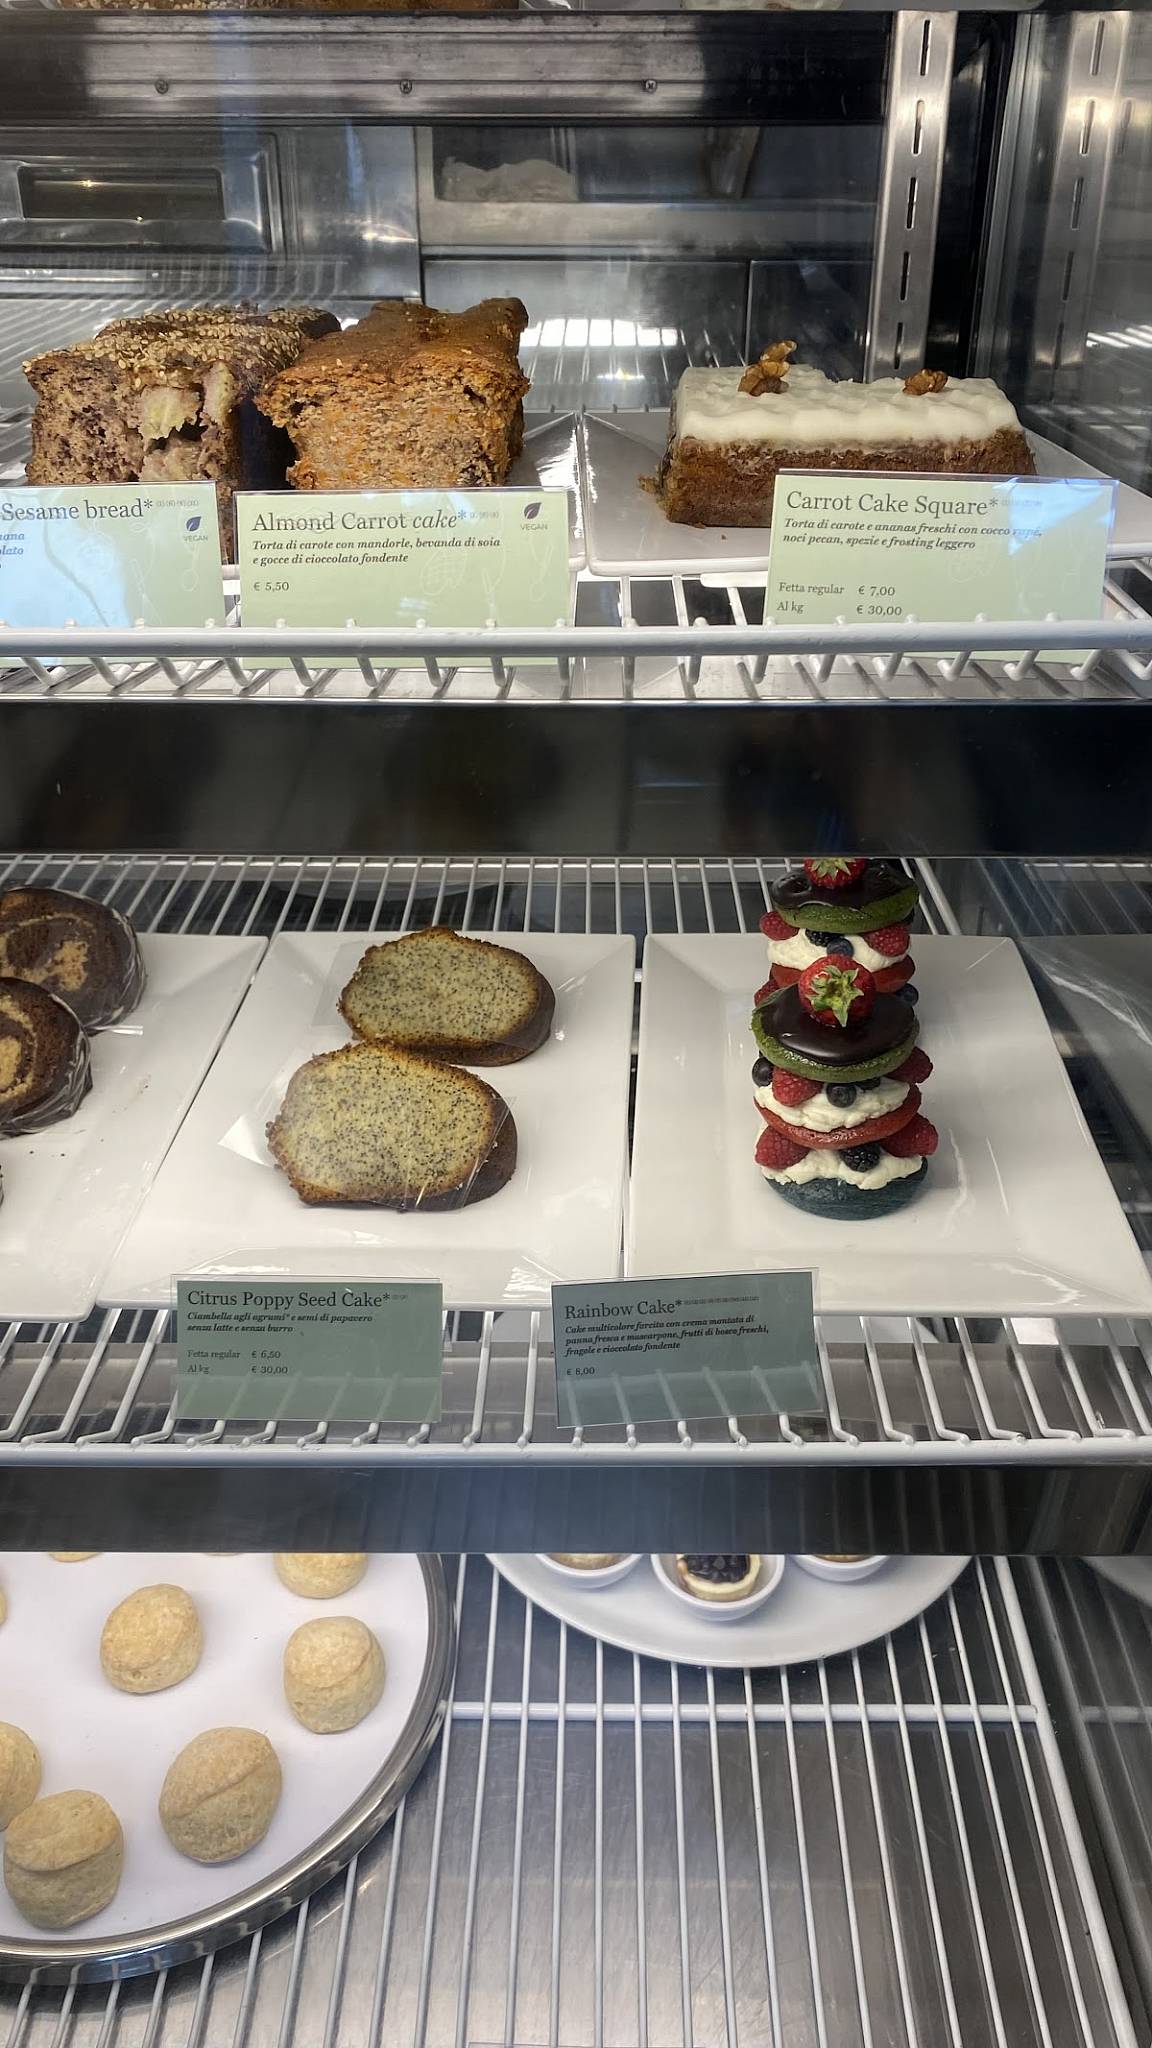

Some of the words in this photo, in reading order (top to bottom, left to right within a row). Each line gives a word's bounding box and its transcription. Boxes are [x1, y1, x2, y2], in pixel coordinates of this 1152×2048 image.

[786, 490, 852, 511] Carrot
[858, 493, 909, 513] Cake
[2, 503, 79, 521] Sesame
[252, 512, 334, 531] Almond
[341, 512, 407, 530] Carrot
[784, 518, 815, 529] Torta
[817, 519, 828, 529] di
[830, 520, 865, 530] carote
[874, 524, 916, 532] ananas
[915, 523, 957, 535] freschi
[958, 526, 977, 534] con
[981, 528, 1010, 536] cocco
[253, 541, 283, 550] Torta
[286, 540, 297, 549] di
[300, 540, 333, 549] carote
[357, 538, 413, 549] mandorle,
[416, 538, 461, 547] bevanda
[464, 538, 475, 547] di
[478, 538, 500, 547] soia
[783, 533, 807, 543] noci
[808, 536, 844, 545] pecan,
[846, 535, 879, 546] spezie
[886, 536, 934, 550] frosting
[936, 538, 976, 550] leggero
[260, 556, 289, 567] gocce
[292, 554, 303, 564] di
[305, 554, 359, 564] cioccolato
[359, 553, 408, 566] fondente
[253, 582, 260, 591] €
[265, 581, 289, 592] 5,50
[778, 582, 805, 593] Fetta
[807, 584, 845, 596] regular
[858, 586, 865, 595] €
[870, 586, 895, 597] 7,00
[776, 601, 789, 611] Al
[791, 601, 804, 614] kg
[856, 605, 863, 614] €
[868, 605, 902, 616] 30,00
[187, 1291, 238, 1305] Citrus
[242, 1291, 294, 1310] Poppy
[298, 1292, 336, 1306] Seed
[187, 1312, 232, 1321] Ciambella
[234, 1312, 251, 1322] agli
[297, 1313, 318, 1321] semi
[320, 1313, 329, 1321] di
[330, 1315, 373, 1323] papavero
[565, 1303, 633, 1319] Rainbow
[214, 1324, 233, 1332] latte
[268, 1324, 293, 1332] burro
[565, 1325, 586, 1334] Cake
[588, 1322, 635, 1332] multicolore
[634, 1321, 665, 1331] farcita
[709, 1316, 744, 1325] montata
[746, 1315, 754, 1323] di
[566, 1337, 592, 1346] panna
[592, 1335, 620, 1344] fresca
[679, 1330, 703, 1339] frutti
[705, 1328, 713, 1336] di
[715, 1328, 737, 1336] bosco
[737, 1325, 769, 1336] freschi,
[187, 1350, 208, 1358] Fetta
[211, 1349, 240, 1359] regular
[251, 1350, 257, 1358] €
[261, 1350, 281, 1359] 6,50
[565, 1346, 595, 1358] fragole
[603, 1344, 643, 1353] cioccolato
[643, 1342, 680, 1352] fondente
[187, 1364, 197, 1372] Al
[199, 1364, 210, 1374] kg
[260, 1366, 288, 1375] 30,00
